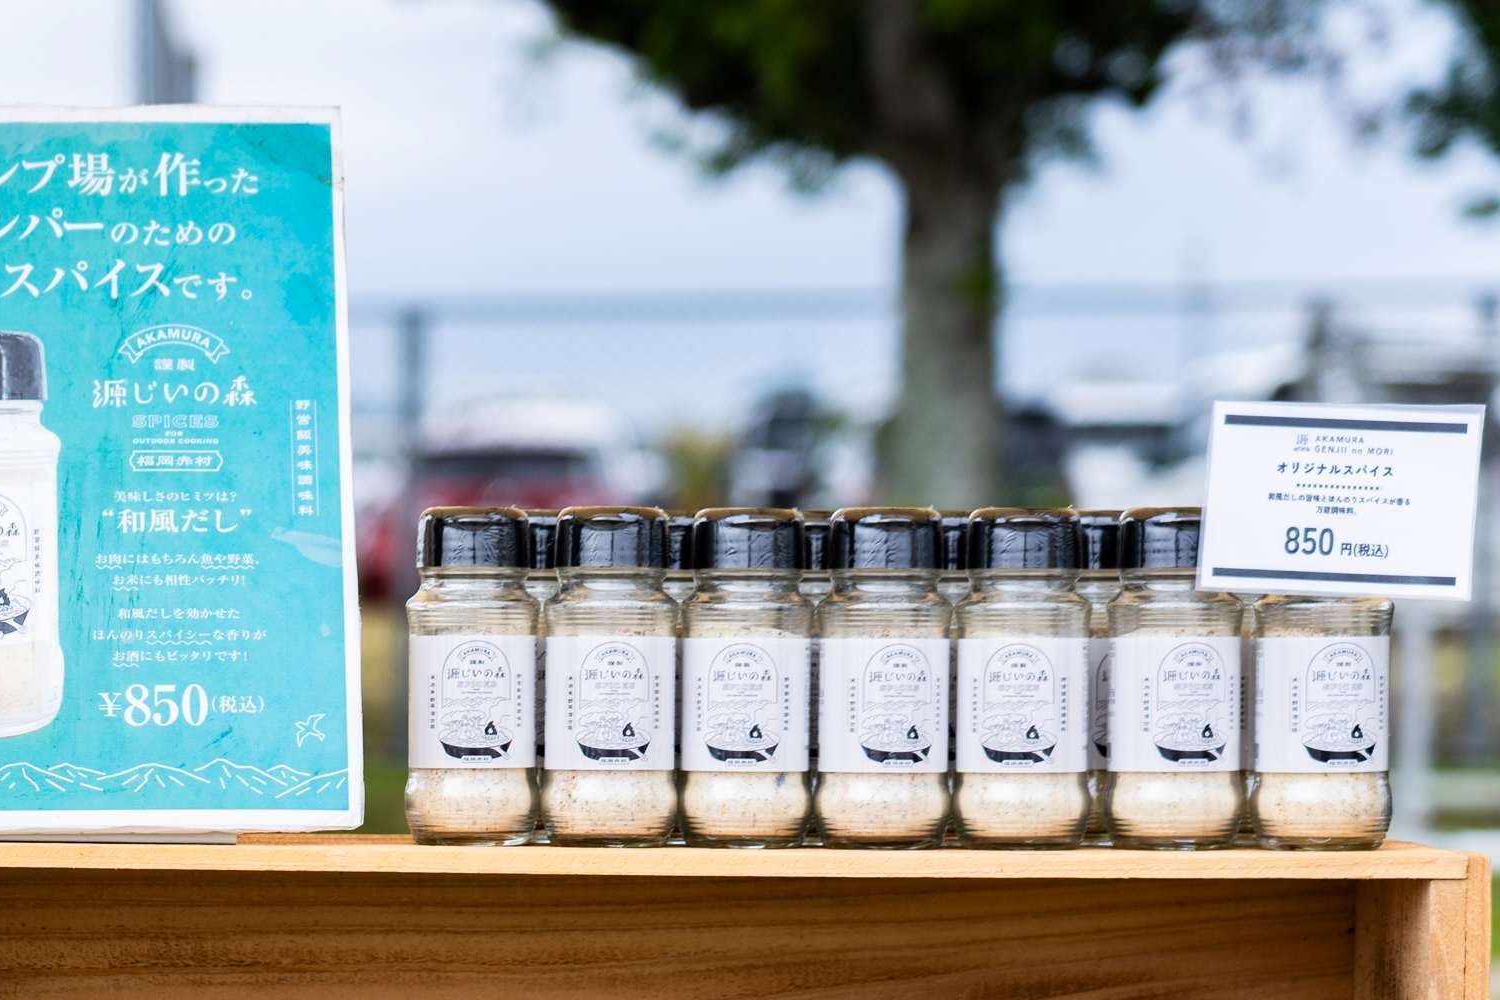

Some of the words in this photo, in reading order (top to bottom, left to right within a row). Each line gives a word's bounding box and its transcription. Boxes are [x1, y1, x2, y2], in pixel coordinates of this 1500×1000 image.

[136, 328, 210, 348] AKAMURA
[154, 358, 196, 371] 謹製
[92, 374, 258, 408] 源じいの森
[132, 414, 220, 429] SPICES
[1314, 435, 1364, 444] AKAMURA
[1314, 446, 1347, 454] GENJII
[1366, 447, 1394, 456] MORI
[137, 455, 213, 467] 福岡赤村
[1276, 461, 1394, 477] オリジナルスパイス
[1284, 526, 1334, 556] 850
[1340, 542, 1390, 559] 円(税込)
[118, 608, 241, 620] 和風だしを効かせた
[92, 629, 267, 641] ほんのりスパイシーな香りが
[447, 665, 506, 679] 源じいの森
[585, 666, 645, 680] 源じいの森
[714, 668, 773, 682] 源じいの森
[869, 668, 928, 683] 源じいの森
[988, 668, 1049, 682] 源じいの森
[1163, 667, 1222, 681] 源じいの森
[1312, 667, 1372, 682] 源じいの森
